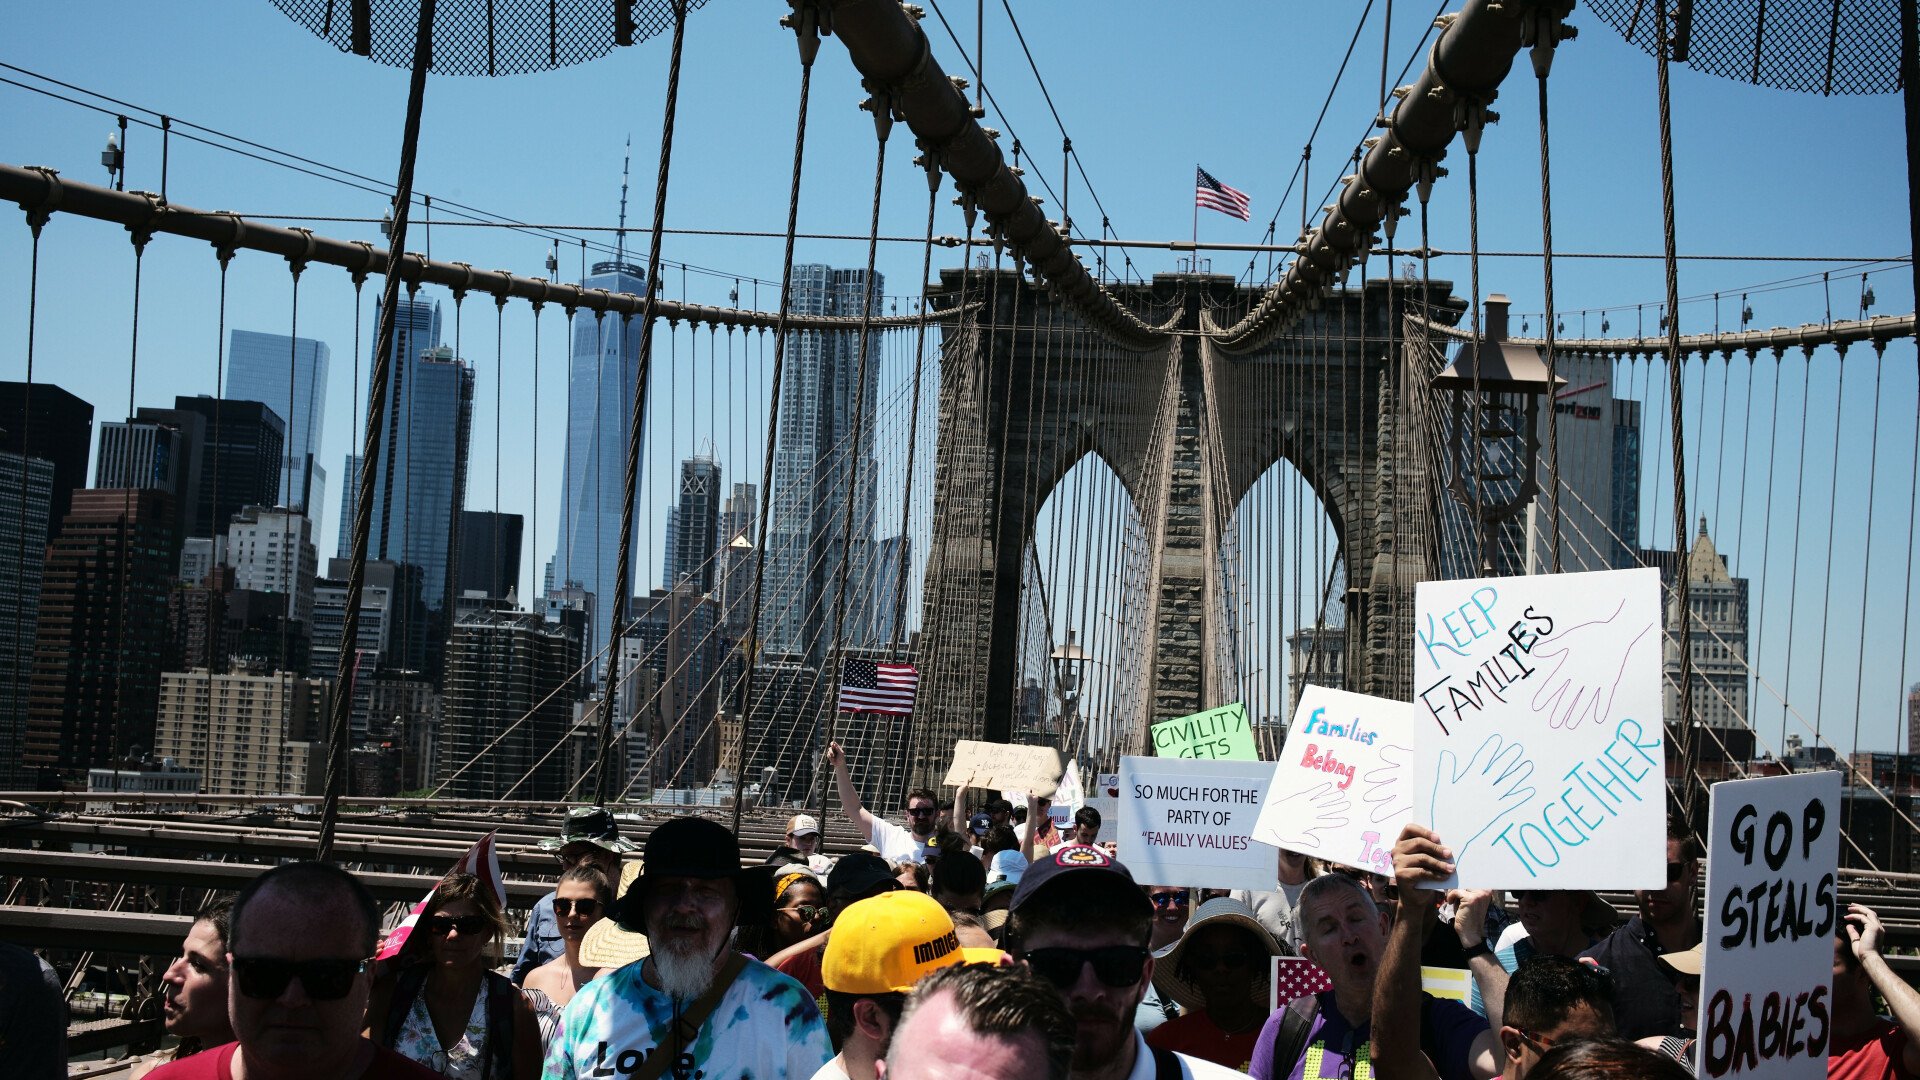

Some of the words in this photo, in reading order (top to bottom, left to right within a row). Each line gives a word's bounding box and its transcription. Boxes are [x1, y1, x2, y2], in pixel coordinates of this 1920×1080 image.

[1555, 402, 1601, 419] erizon
[1418, 586, 1498, 670] KEEP
[1419, 605, 1554, 736] FAMILIES
[1303, 706, 1378, 746] Families
[1299, 743, 1356, 791] Belong
[1134, 784, 1153, 799] SO
[1156, 785, 1199, 801] MUCH
[1202, 787, 1229, 803] FOR
[1232, 788, 1258, 804] THE
[1491, 719, 1661, 877] TOGETHER
[1142, 831, 1195, 847] “FAMILY
[1167, 809, 1210, 825] PARTY
[1212, 811, 1231, 826] OF
[1730, 797, 1826, 872] GOP
[1358, 831, 1394, 874] Tog
[1720, 872, 1835, 951] STEALS
[1705, 984, 1830, 1079] BABIES
[592, 1041, 703, 1080] Loe.
